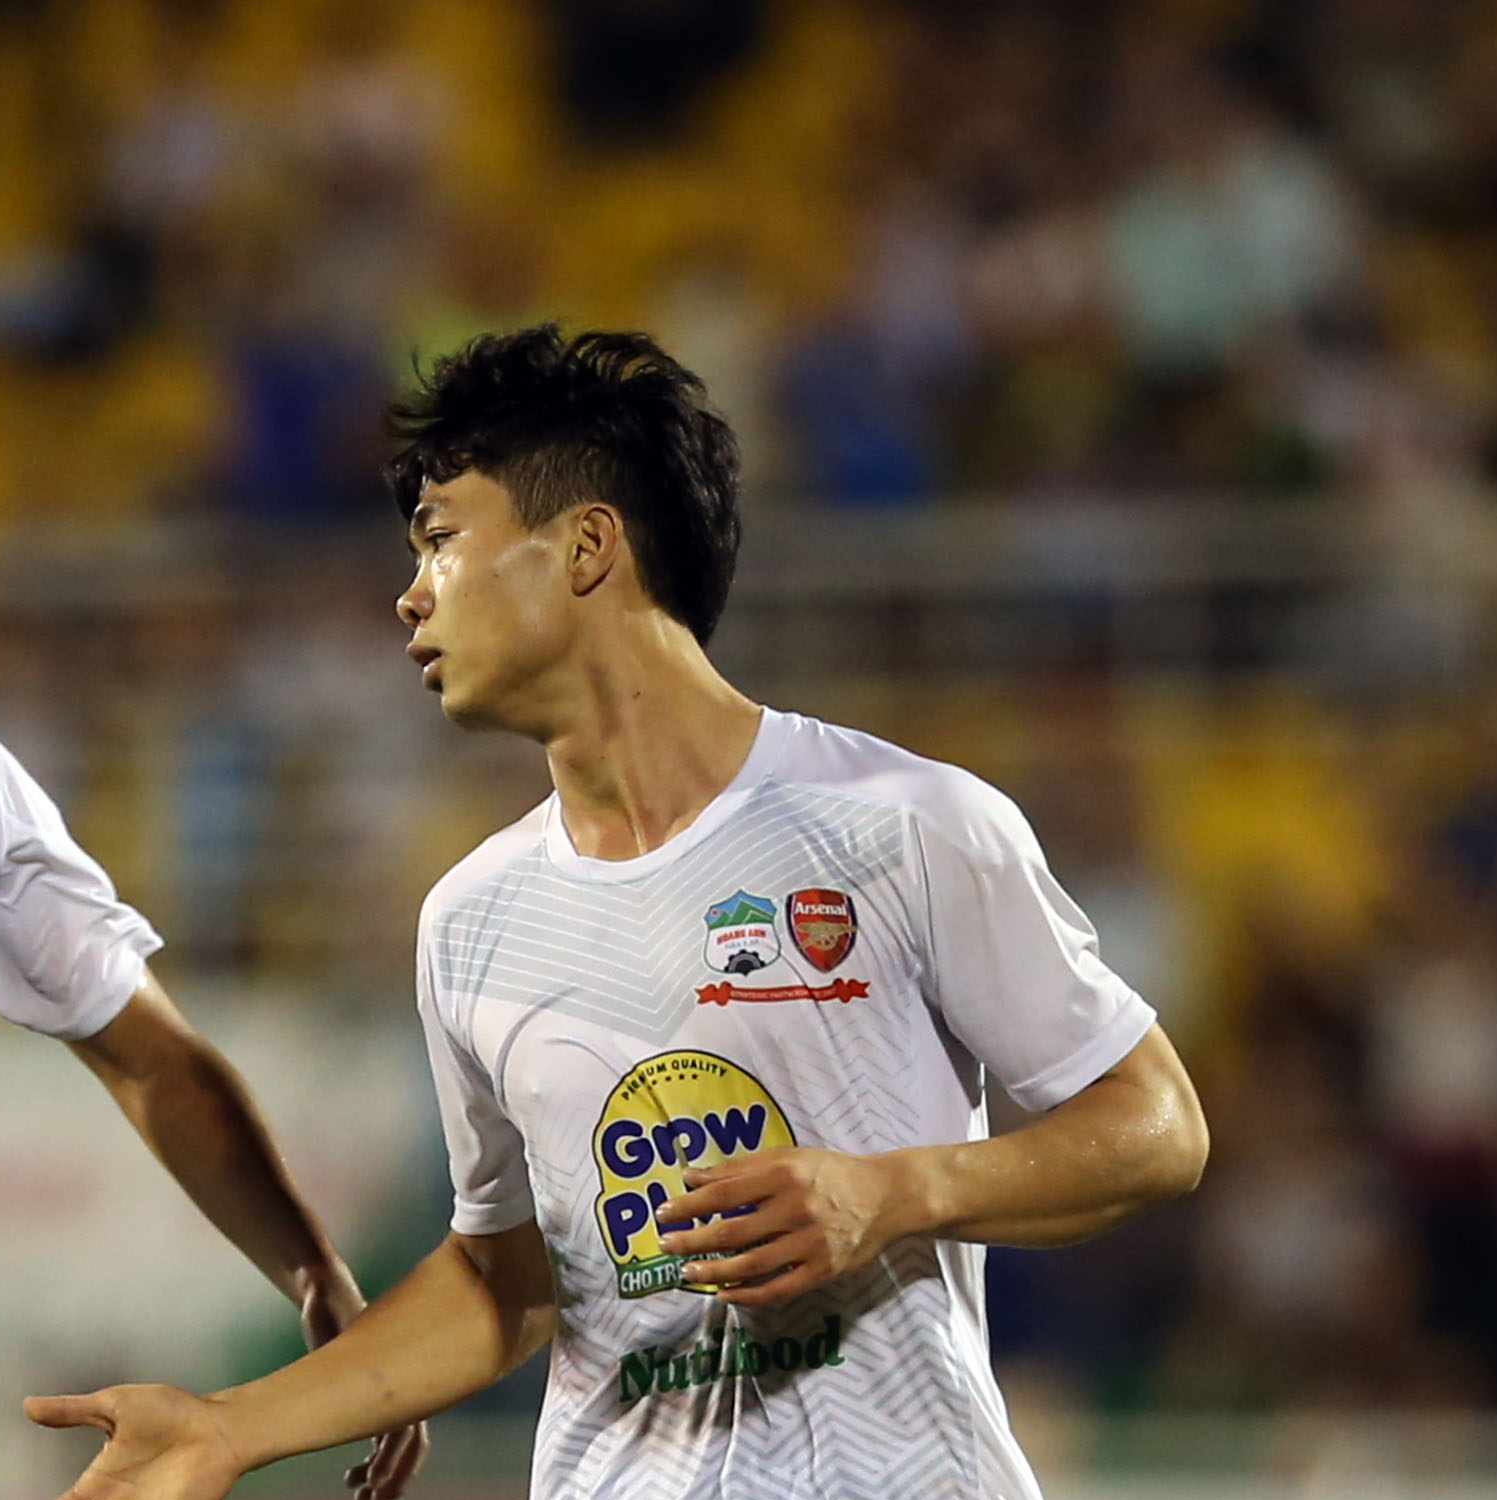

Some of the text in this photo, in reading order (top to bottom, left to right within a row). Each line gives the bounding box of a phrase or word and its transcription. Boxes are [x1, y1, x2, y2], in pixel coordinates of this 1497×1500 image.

[794, 901, 847, 916] Arsenal
[671, 1058, 728, 1078] QUALITY
[620, 1268, 652, 1292] CHO
